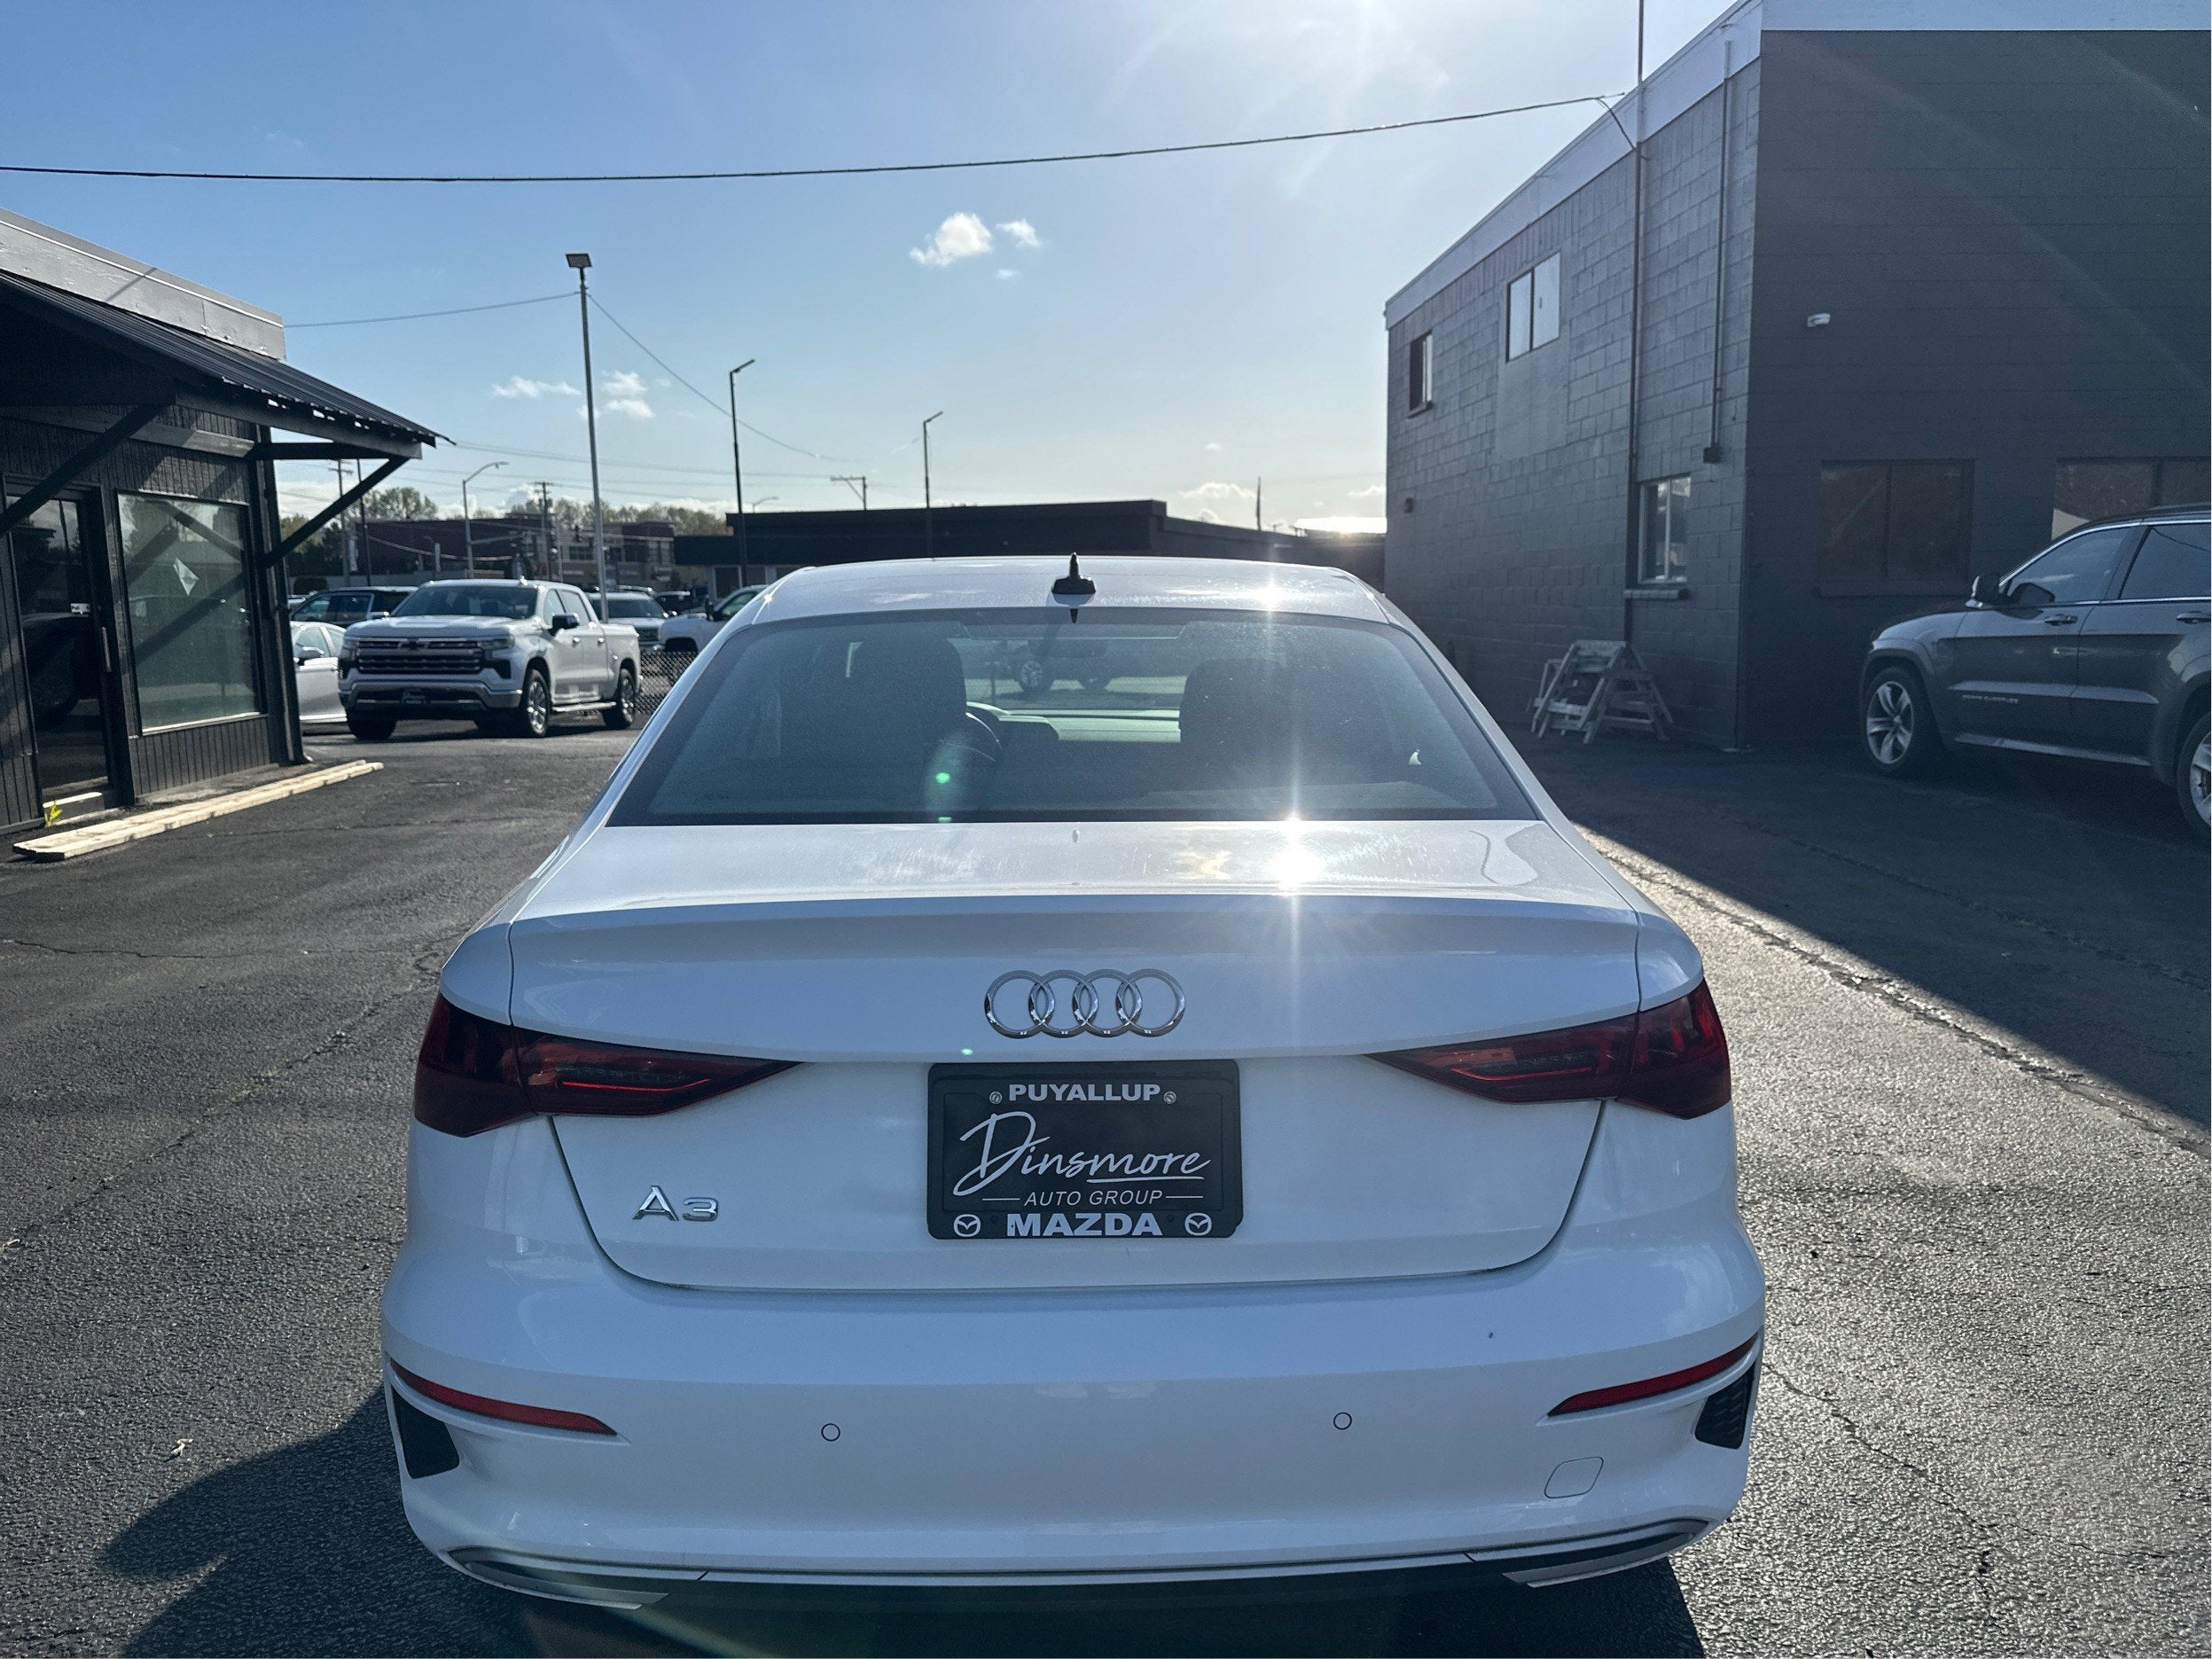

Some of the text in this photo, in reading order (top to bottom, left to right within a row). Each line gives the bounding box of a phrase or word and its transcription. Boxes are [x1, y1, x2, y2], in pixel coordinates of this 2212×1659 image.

[1009, 1084, 1161, 1102] PUYALLUP
[953, 1111, 1211, 1196] Dinsmore
[632, 1185, 719, 1222] A3
[1024, 1189, 1162, 1207] AUTO GROUP
[1006, 1213, 1162, 1237] MAZDA
